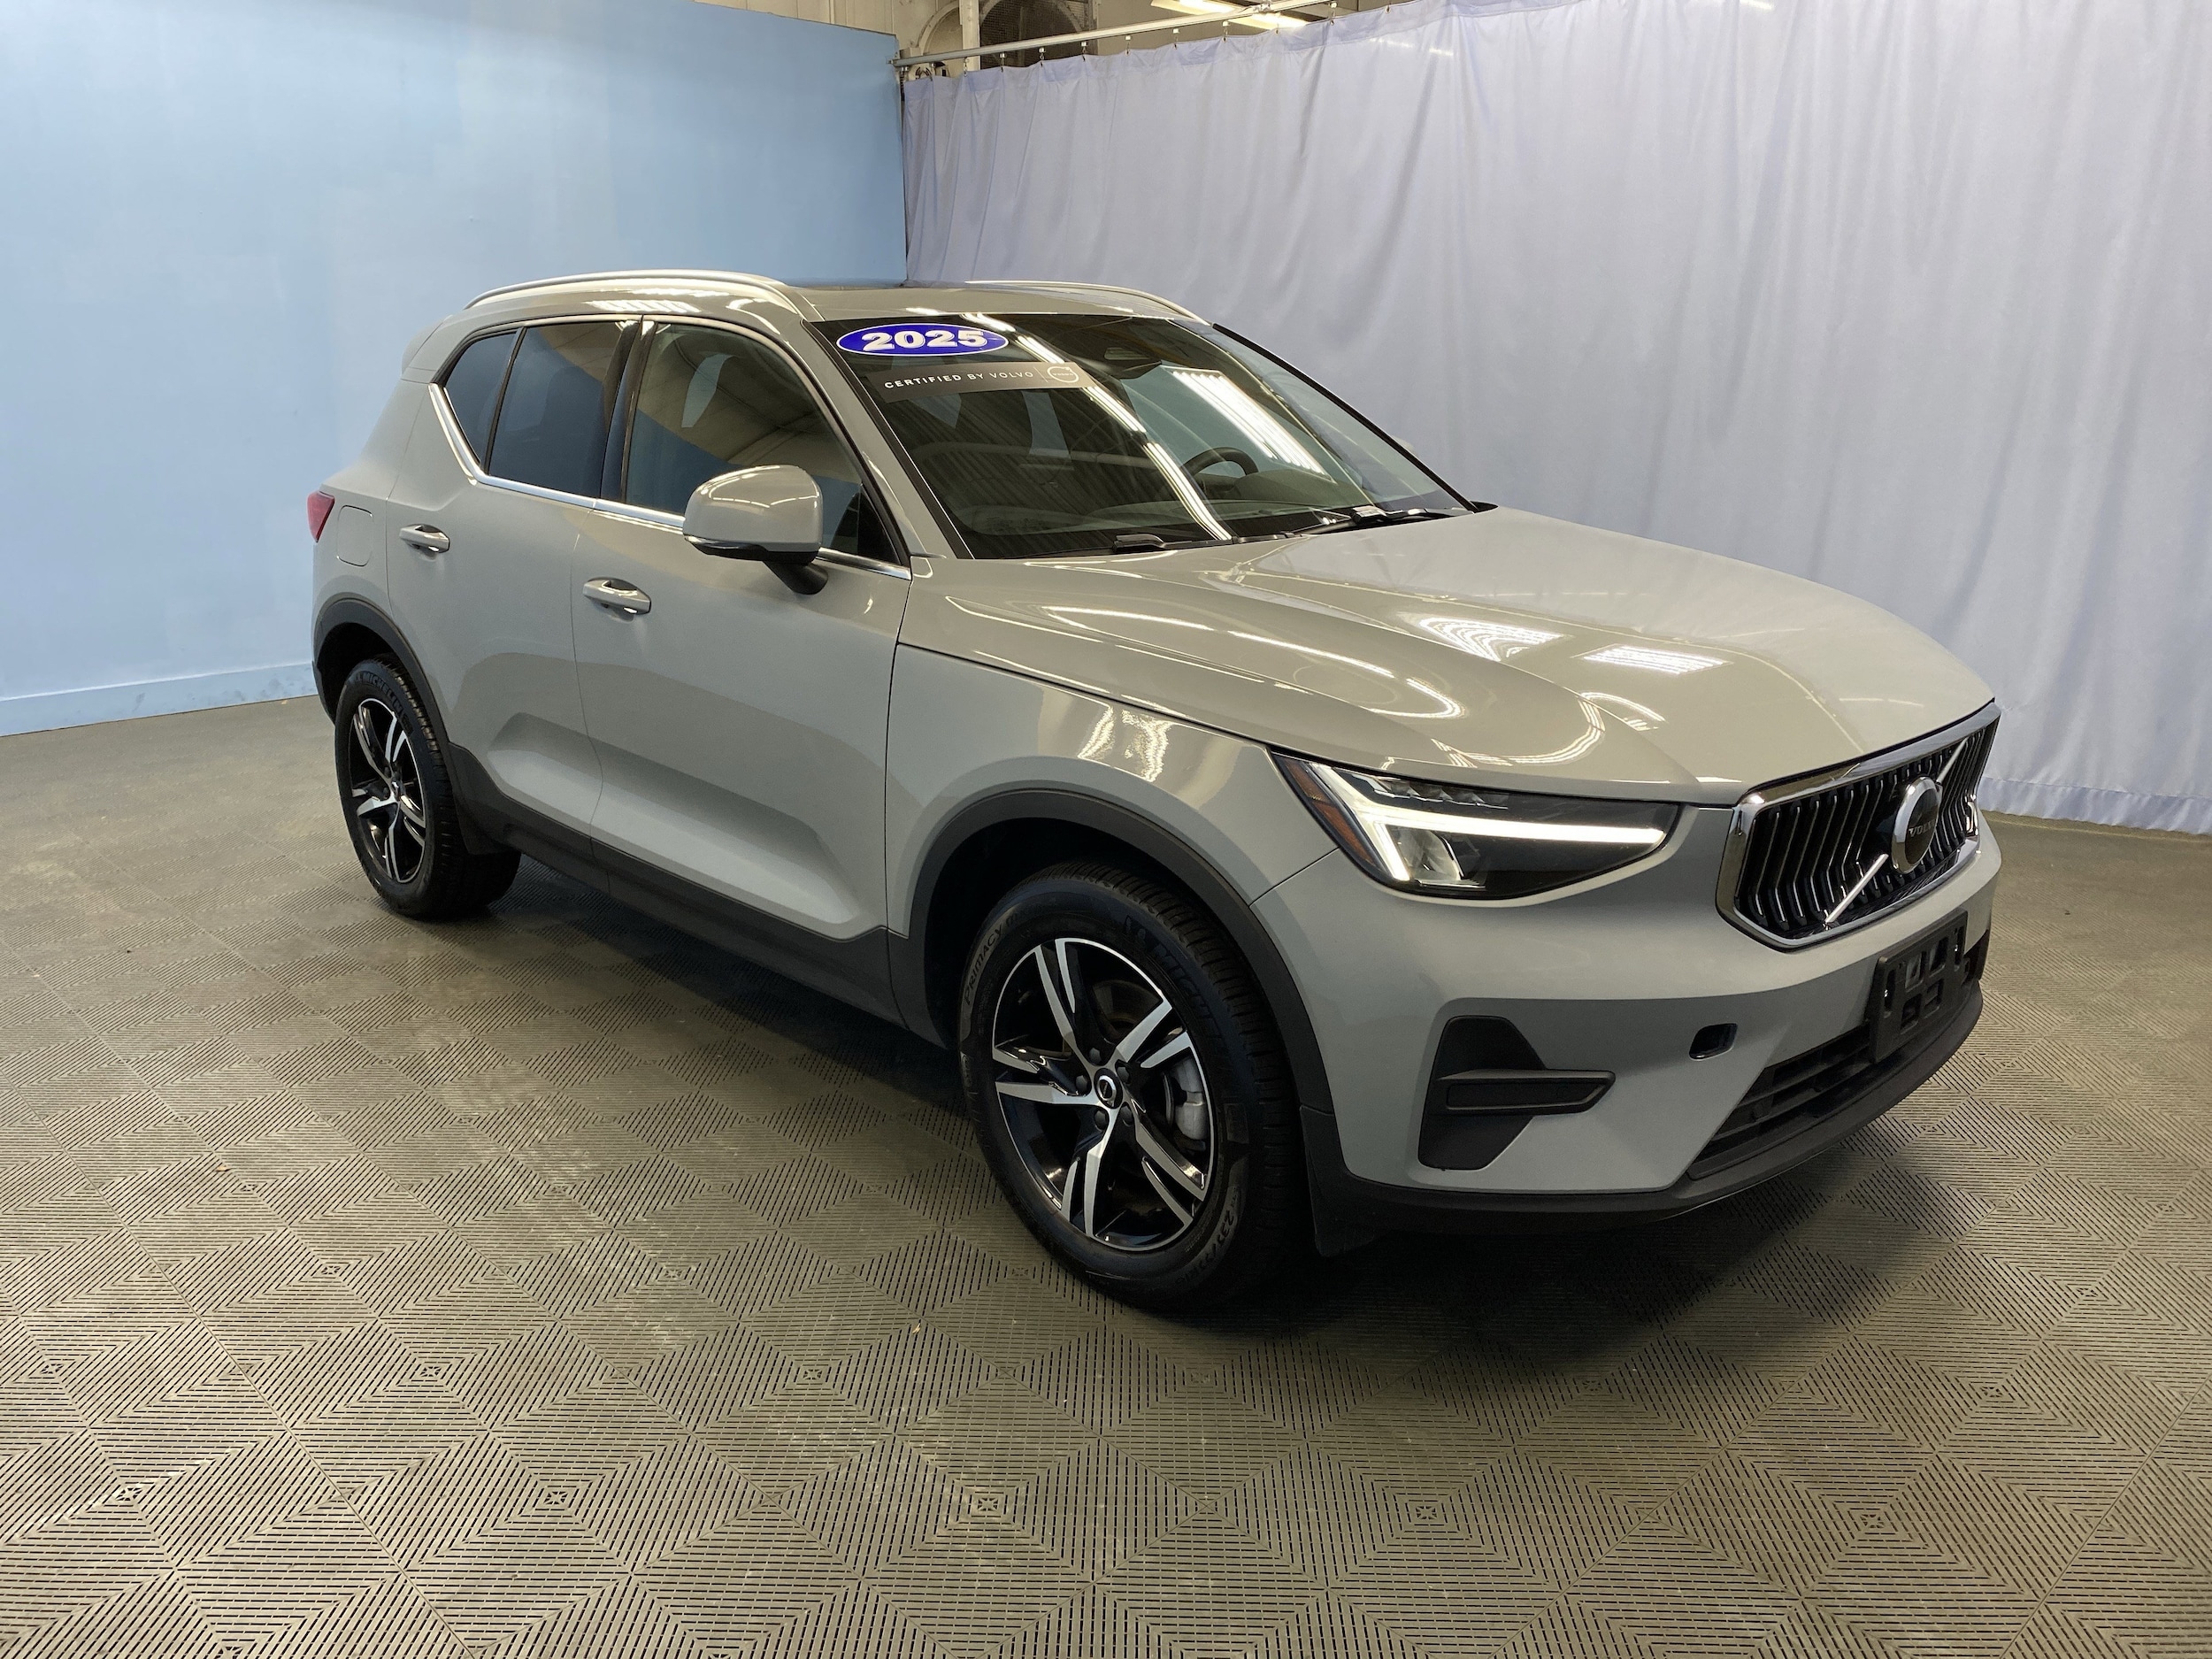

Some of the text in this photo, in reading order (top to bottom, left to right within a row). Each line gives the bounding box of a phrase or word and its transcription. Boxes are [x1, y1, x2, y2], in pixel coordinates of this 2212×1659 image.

[862, 330, 987, 351] 2025
[885, 375, 961, 388] CERTIFIED
[362, 671, 403, 714] MICHELIN
[964, 926, 1002, 1005] PRIMACY
